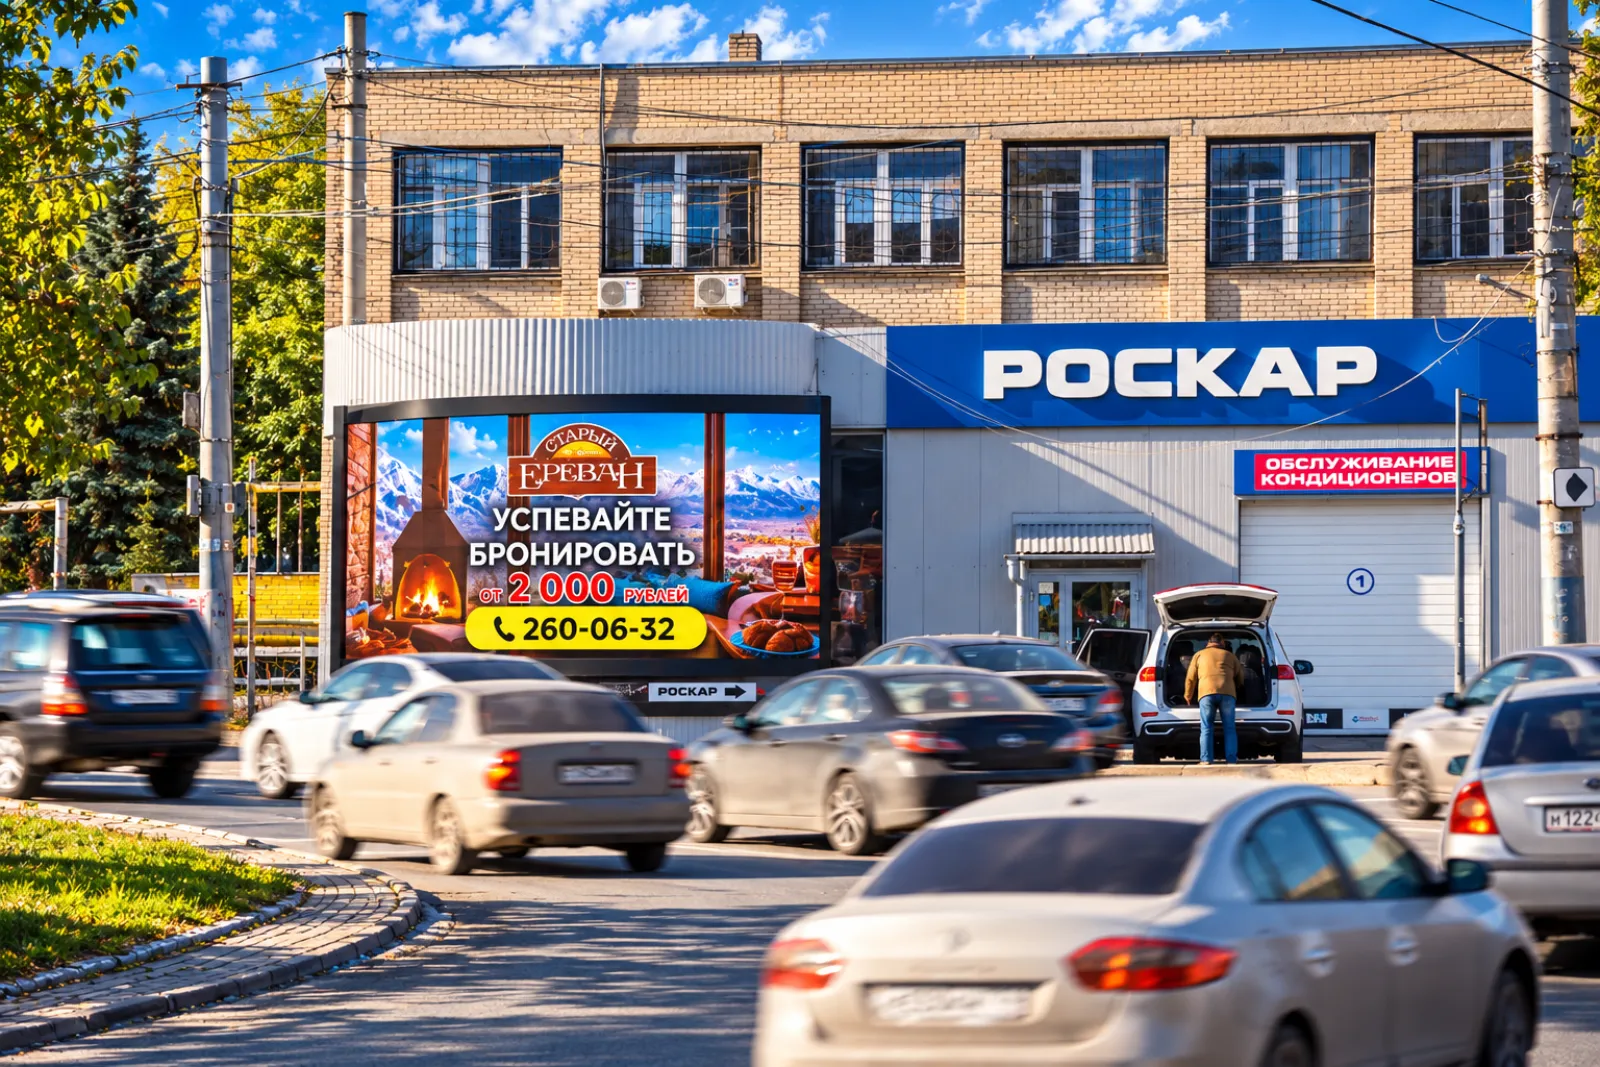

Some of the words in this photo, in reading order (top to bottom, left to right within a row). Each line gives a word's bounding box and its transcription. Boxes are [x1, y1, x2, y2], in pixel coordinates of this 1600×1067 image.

[982, 345, 1378, 400] РОСКАР
[545, 427, 618, 452] СТАРЫЙ
[1265, 455, 1454, 471] ОБСЛУЖИВАНИЕ
[518, 462, 645, 490] ЕРЕВАН
[1261, 471, 1458, 487] КОНДИЦИОНЕРОВ
[492, 500, 672, 531] УСПЕВАЙТЕ
[469, 541, 696, 566] БРОНИРОВАТЬ
[623, 584, 690, 603] РУБЛЕЙ
[523, 617, 675, 641] 260-06-32
[657, 686, 718, 697] РОСКАР
